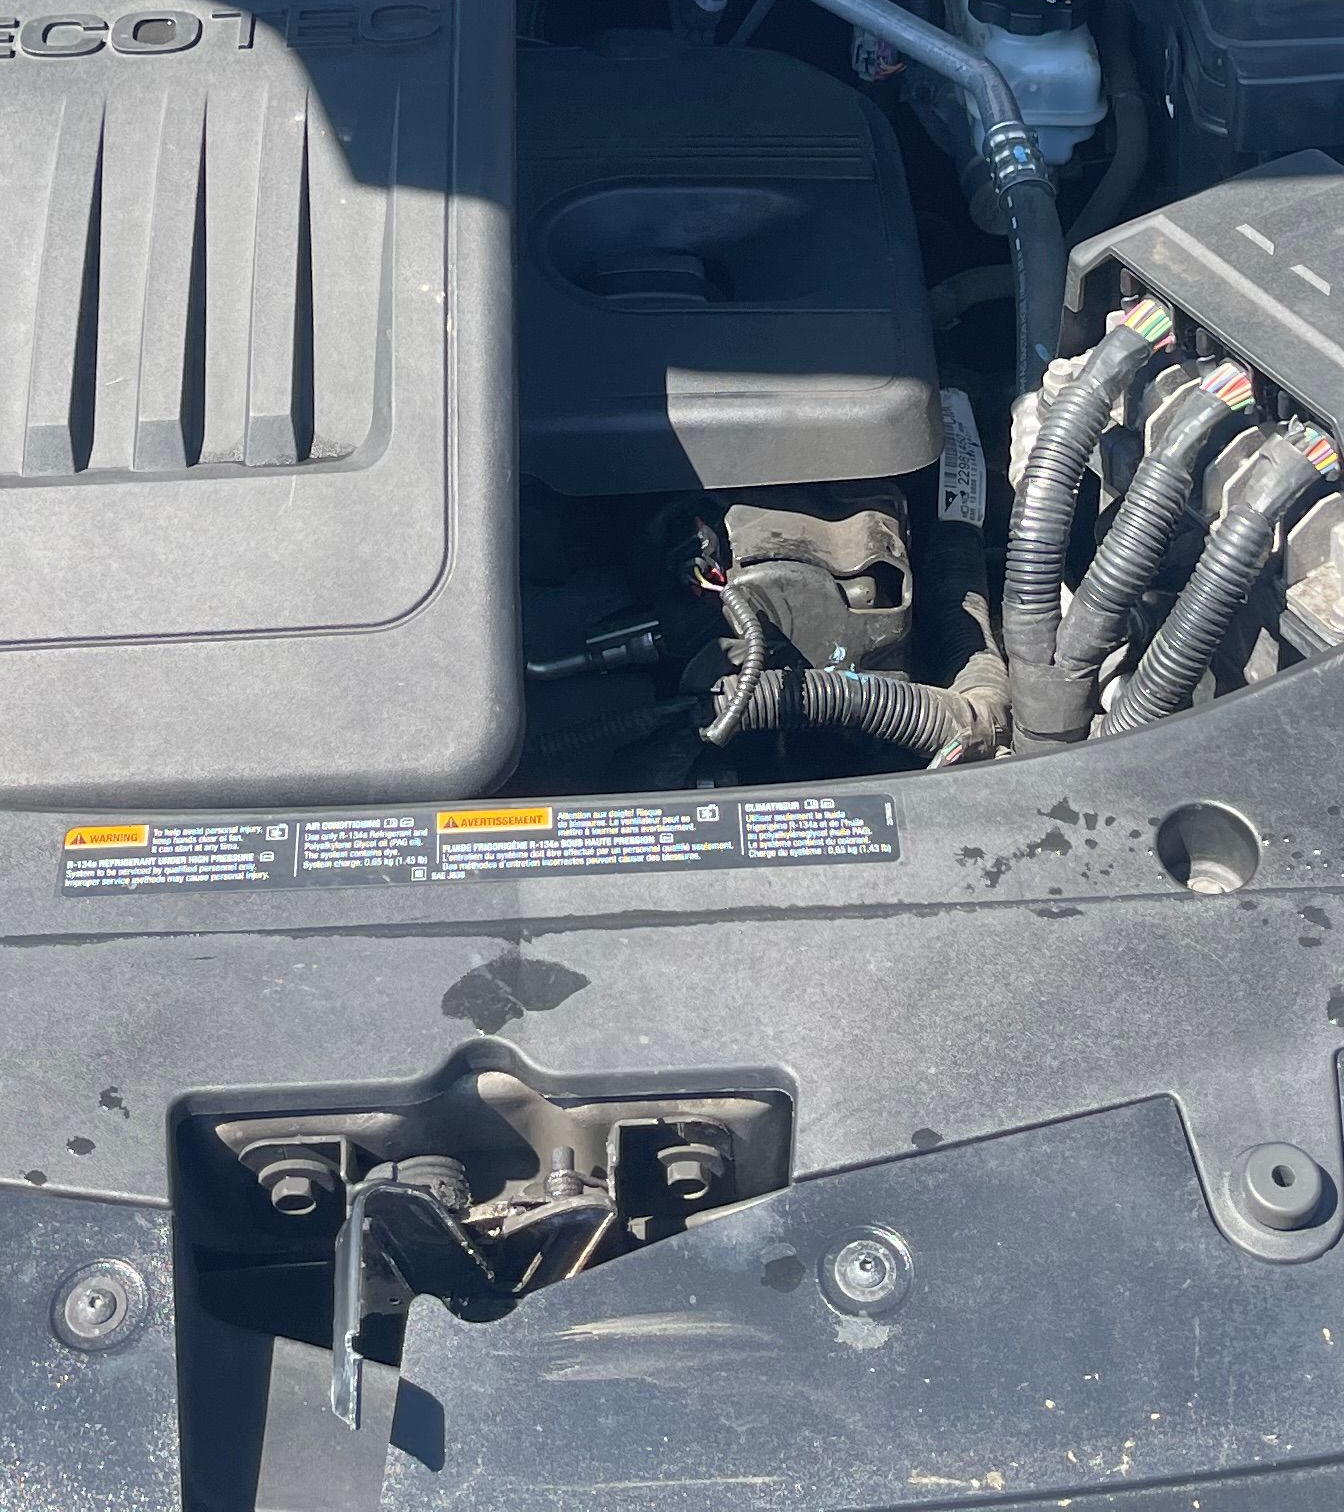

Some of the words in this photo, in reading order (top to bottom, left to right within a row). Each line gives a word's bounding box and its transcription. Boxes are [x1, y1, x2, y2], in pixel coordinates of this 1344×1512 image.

[305, 822, 320, 830] AIR
[322, 820, 381, 830] CONDITIONING
[461, 816, 543, 827] AVERTISSEMENT
[789, 821, 818, 829] R-134a
[154, 829, 163, 837] To
[165, 828, 181, 838] help
[205, 826, 238, 836] personal
[321, 833, 338, 842] only
[413, 829, 428, 837] and
[90, 833, 138, 843] WARNING
[530, 840, 559, 848] R-134a
[585, 838, 612, 847] HAUTE
[354, 840, 377, 849] Glycol
[320, 851, 348, 860] system
[350, 849, 382, 857] contains
[749, 850, 776, 859] Charge
[848, 846, 858, 854] kg
[67, 860, 97, 869] R-134a
[99, 857, 156, 868] REFRIGERANT
[158, 857, 187, 865] UNDER
[211, 854, 254, 863] PRESSURE
[303, 861, 332, 870] System
[384, 858, 394, 866] kg
[66, 869, 95, 879] System
[153, 867, 162, 876] by
[65, 879, 100, 888] Improper
[132, 876, 166, 884] methods
[167, 876, 184, 884] may
[211, 873, 244, 881] personal
